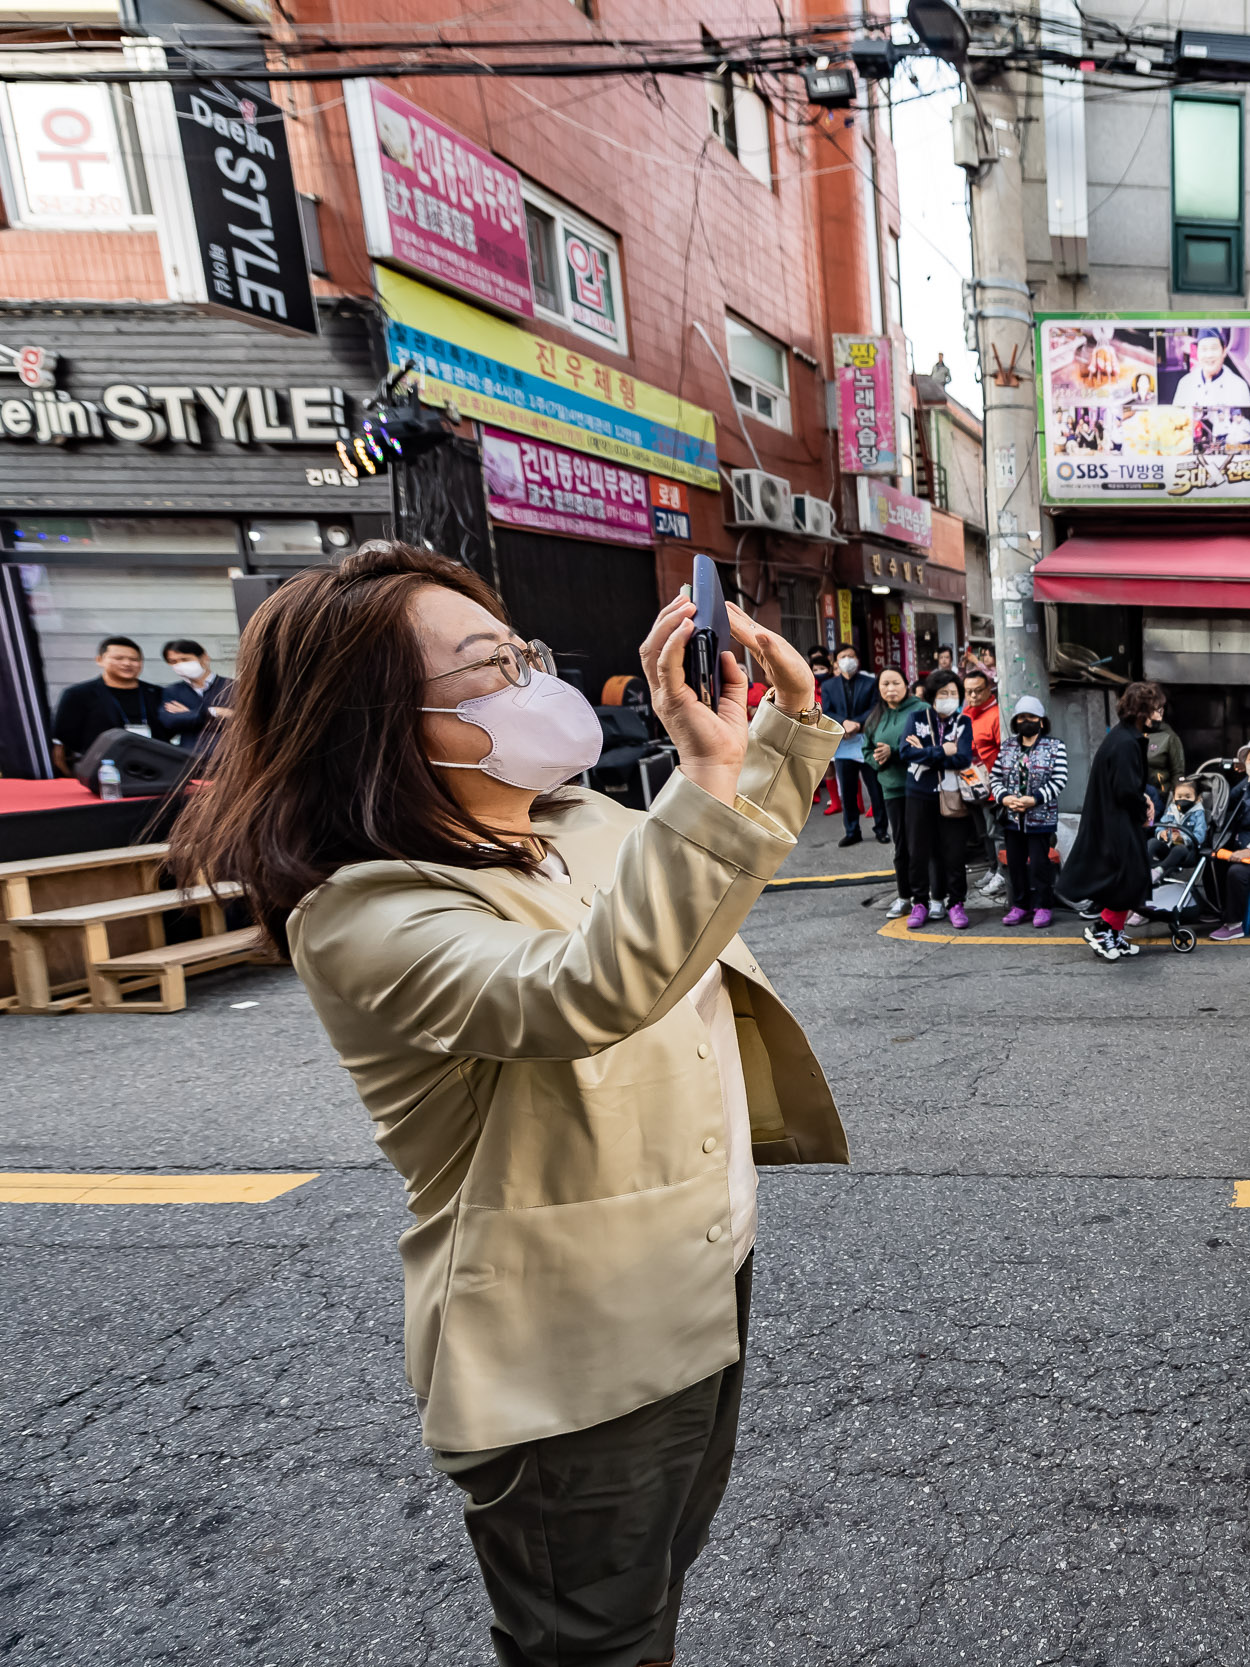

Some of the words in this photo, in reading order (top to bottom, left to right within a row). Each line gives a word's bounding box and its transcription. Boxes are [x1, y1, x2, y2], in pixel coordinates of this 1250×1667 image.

[36, 108, 109, 190] 우
[214, 146, 288, 319] STYLE
[568, 239, 606, 311] 압
[103, 385, 348, 442] STYLE
[520, 442, 648, 508] 건대동안피부관리
[1076, 463, 1109, 479] SBS
